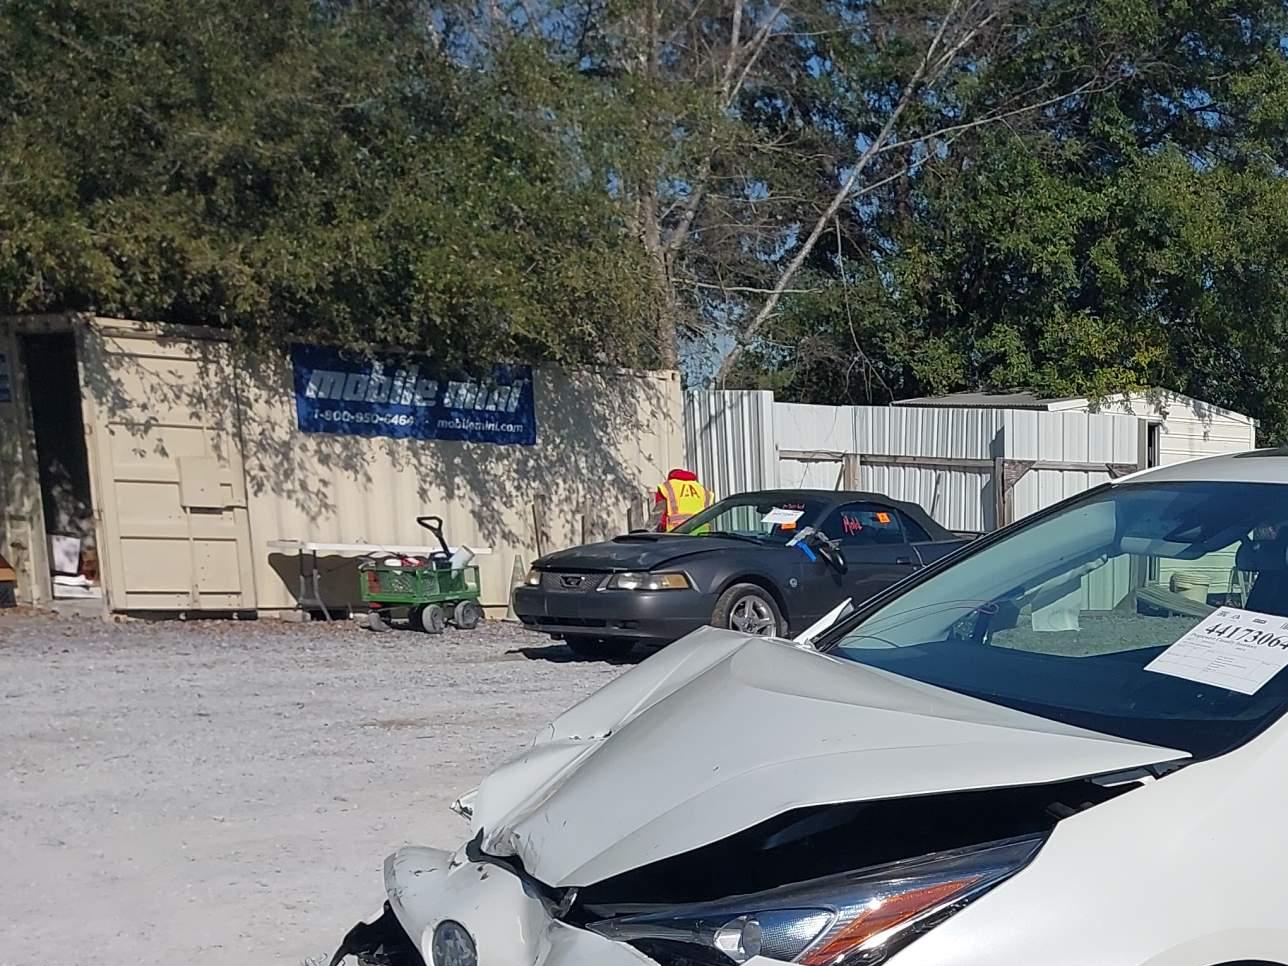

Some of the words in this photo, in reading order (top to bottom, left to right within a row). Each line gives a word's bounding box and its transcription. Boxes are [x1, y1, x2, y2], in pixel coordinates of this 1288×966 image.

[306, 362, 437, 407] mobile
[443, 379, 524, 413] mini
[437, 417, 524, 434] mobilemini.com
